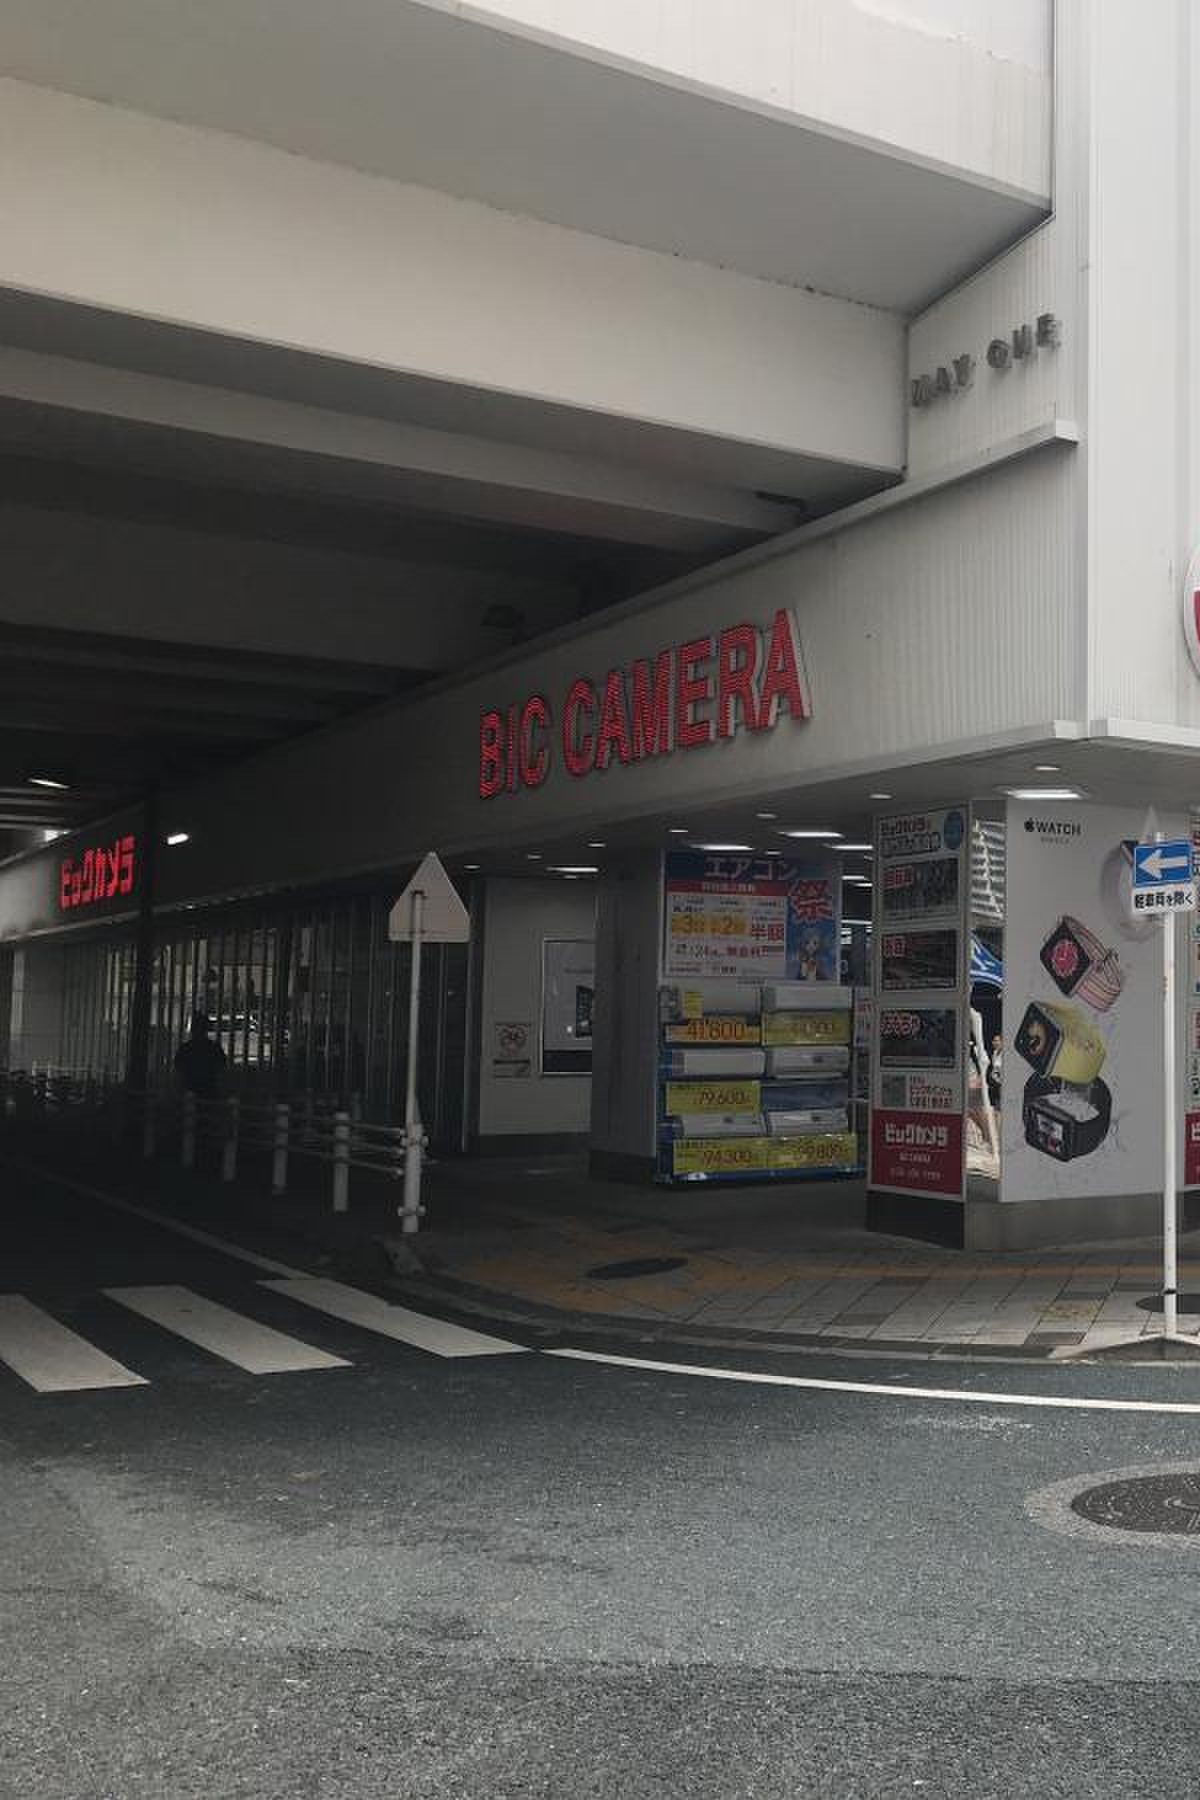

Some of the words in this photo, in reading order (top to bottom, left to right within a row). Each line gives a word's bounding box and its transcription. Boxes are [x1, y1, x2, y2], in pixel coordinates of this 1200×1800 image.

[479, 694, 550, 800] BIC
[562, 606, 813, 781] CAMERA
[1035, 820, 1082, 837] WATCH
[703, 856, 800, 881] エアコン
[885, 1122, 949, 1147] ビックカメラ
